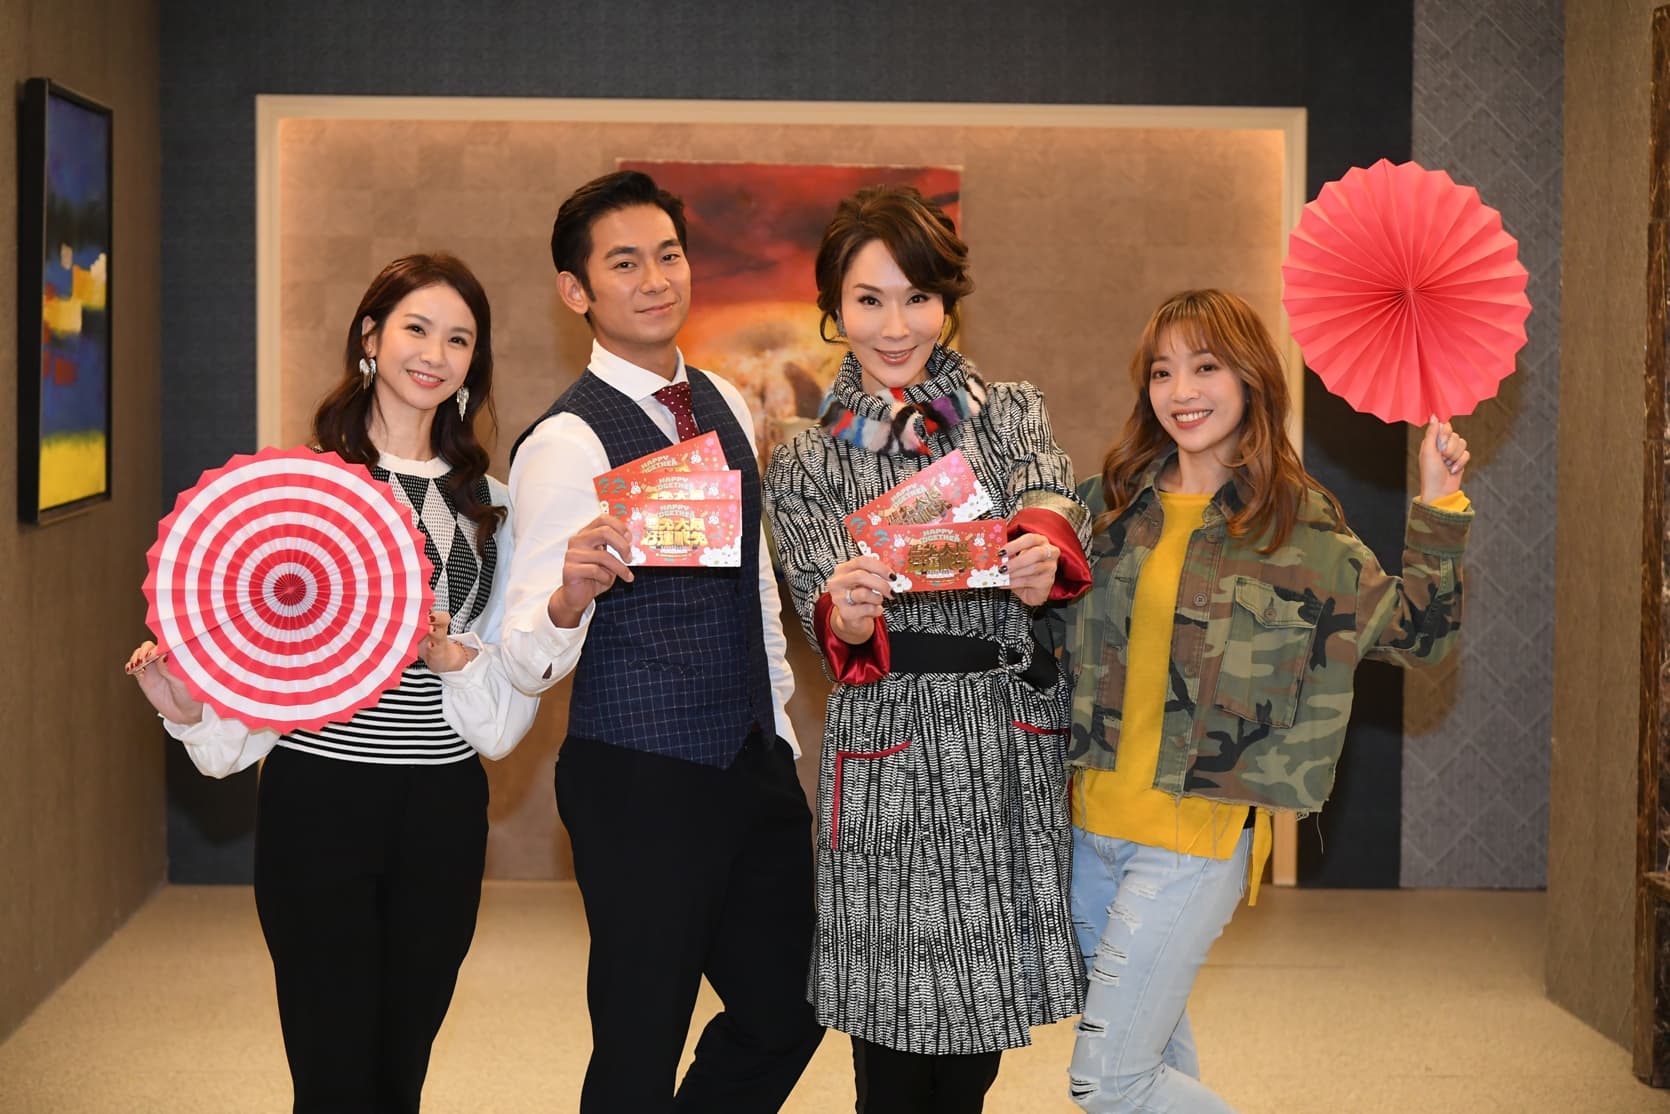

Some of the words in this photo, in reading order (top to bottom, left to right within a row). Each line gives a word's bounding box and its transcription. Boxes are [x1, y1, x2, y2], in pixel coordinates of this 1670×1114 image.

[641, 455, 669, 469] HAPPY
[923, 528, 954, 536] HAPPY
[920, 534, 960, 543] TOGETHER
